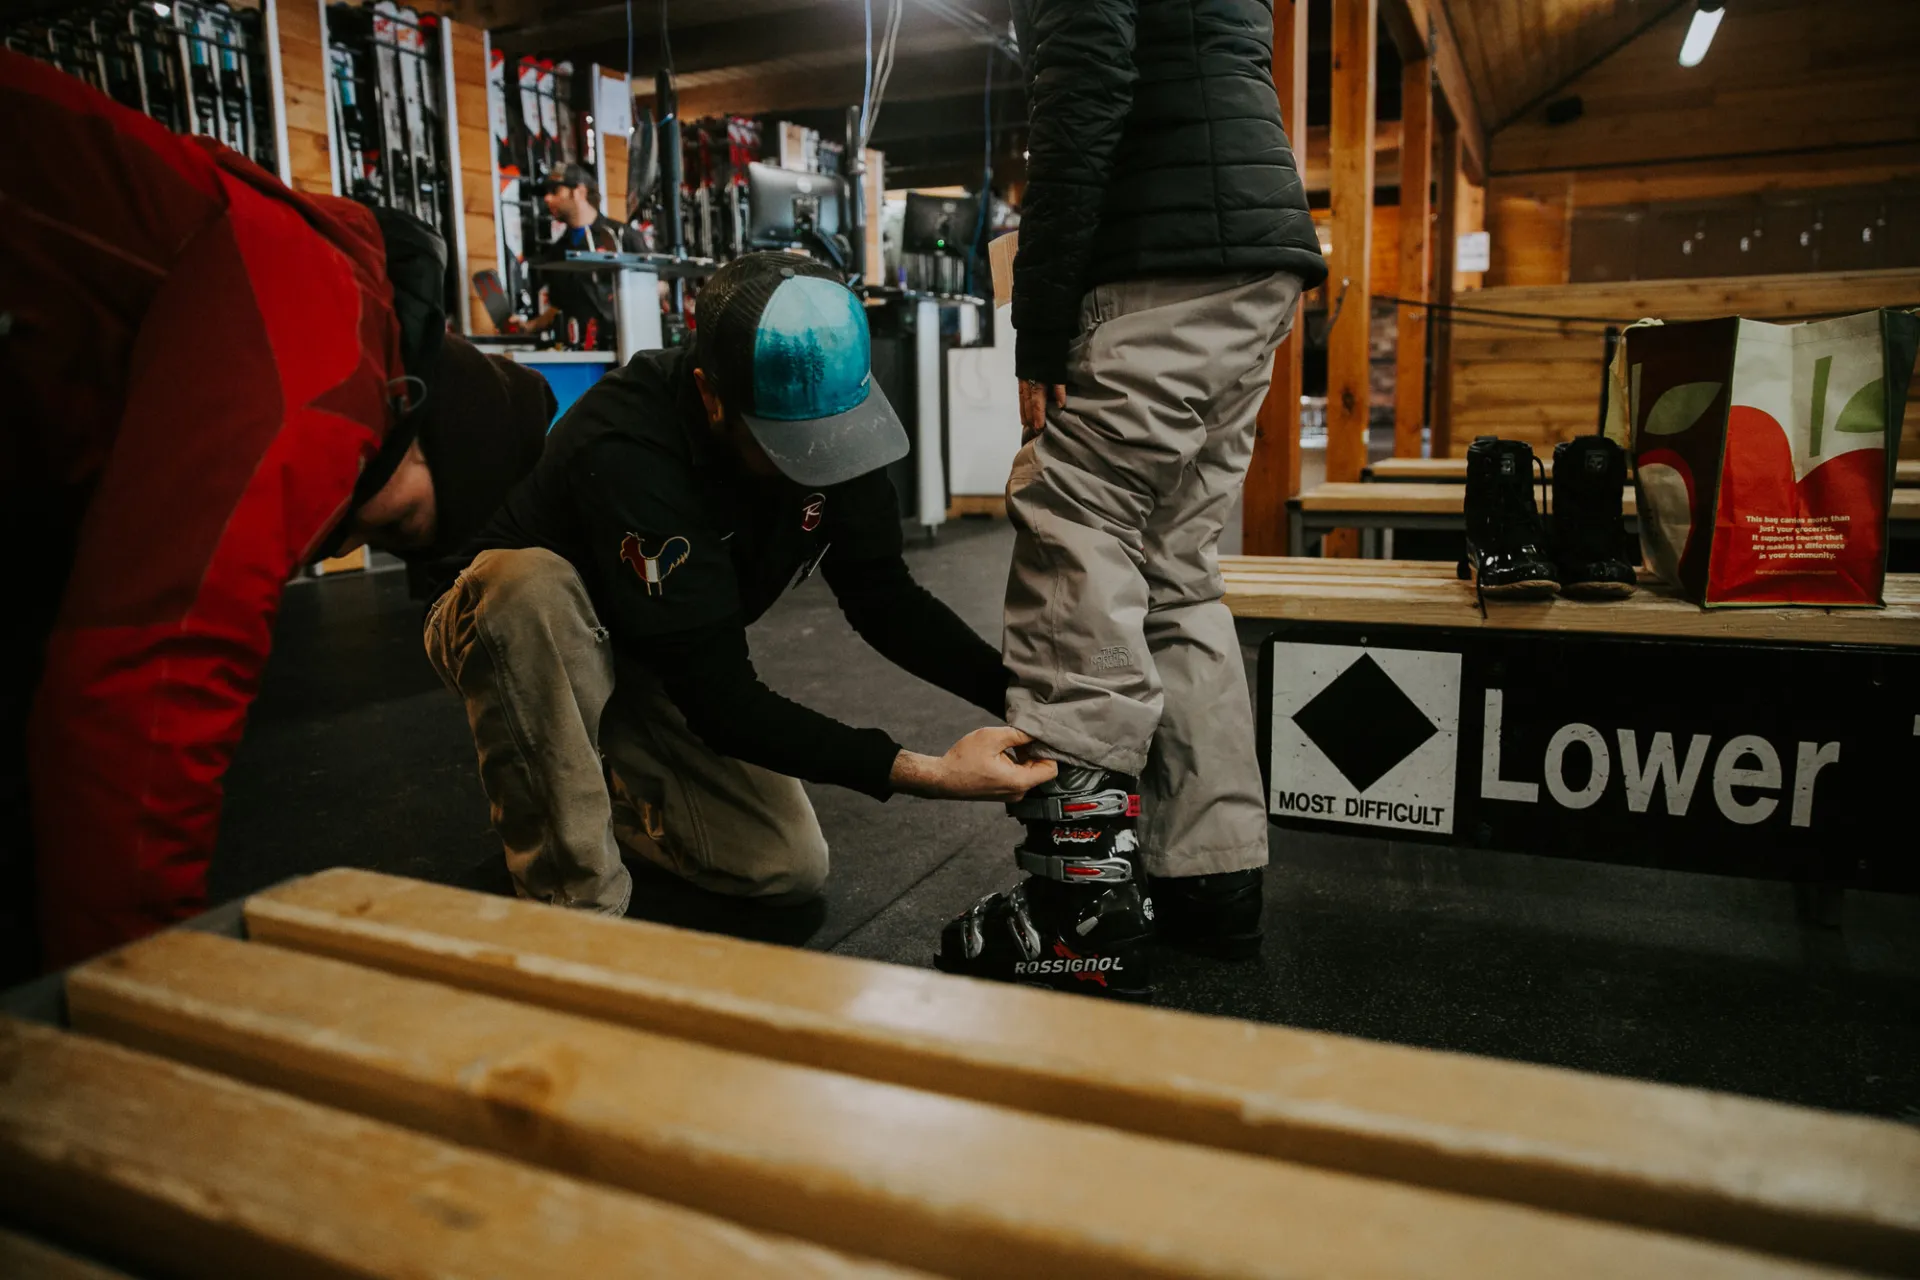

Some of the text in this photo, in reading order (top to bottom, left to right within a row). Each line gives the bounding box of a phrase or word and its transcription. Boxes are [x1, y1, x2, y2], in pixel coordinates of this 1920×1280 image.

[1759, 525, 1774, 533] just
[1101, 647, 1119, 656] THE
[1480, 688, 1840, 828] Lower
[1279, 791, 1445, 826] MOST DIFFICULT
[1014, 957, 1124, 974] ROSSIGNOL
